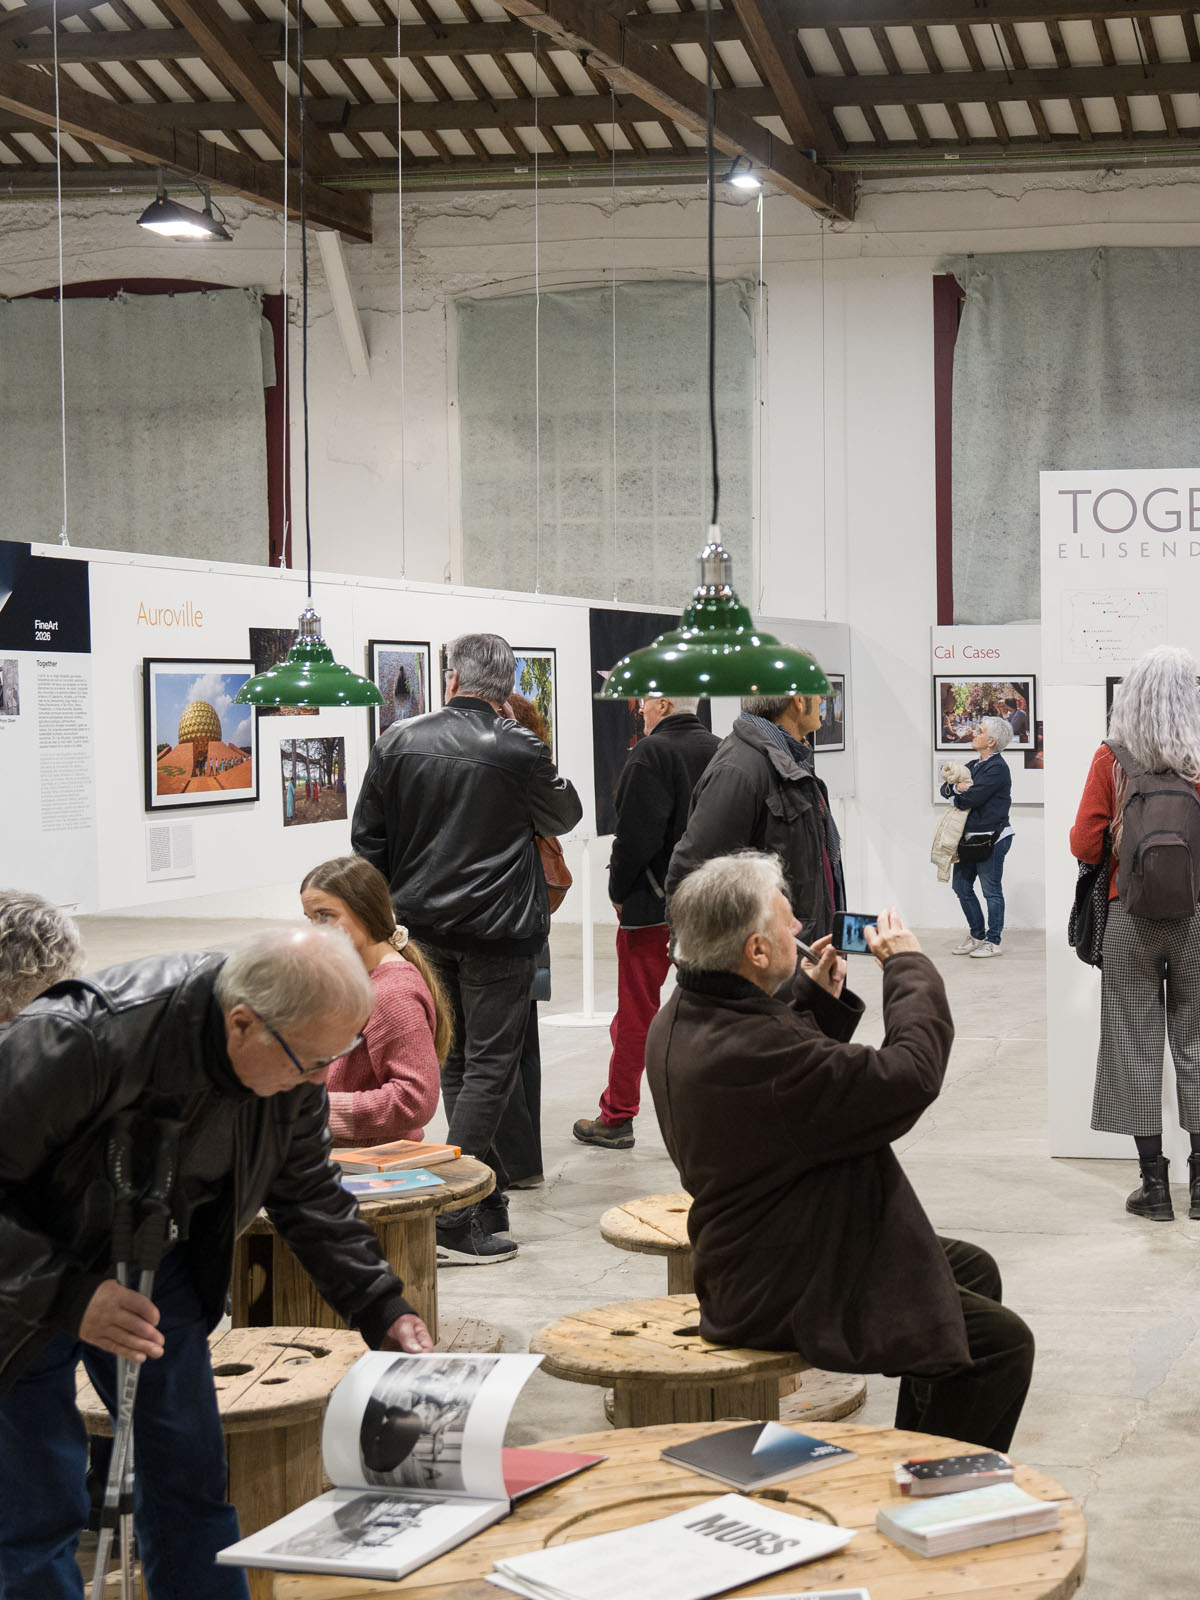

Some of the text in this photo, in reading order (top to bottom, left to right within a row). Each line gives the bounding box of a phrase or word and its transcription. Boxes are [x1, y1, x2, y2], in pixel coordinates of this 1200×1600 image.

[136, 600, 204, 627] Auroville
[34, 619, 59, 630] FineArt
[934, 644, 1001, 660] Cal Cases
[36, 659, 58, 669] Together
[683, 1512, 801, 1556] MURS
